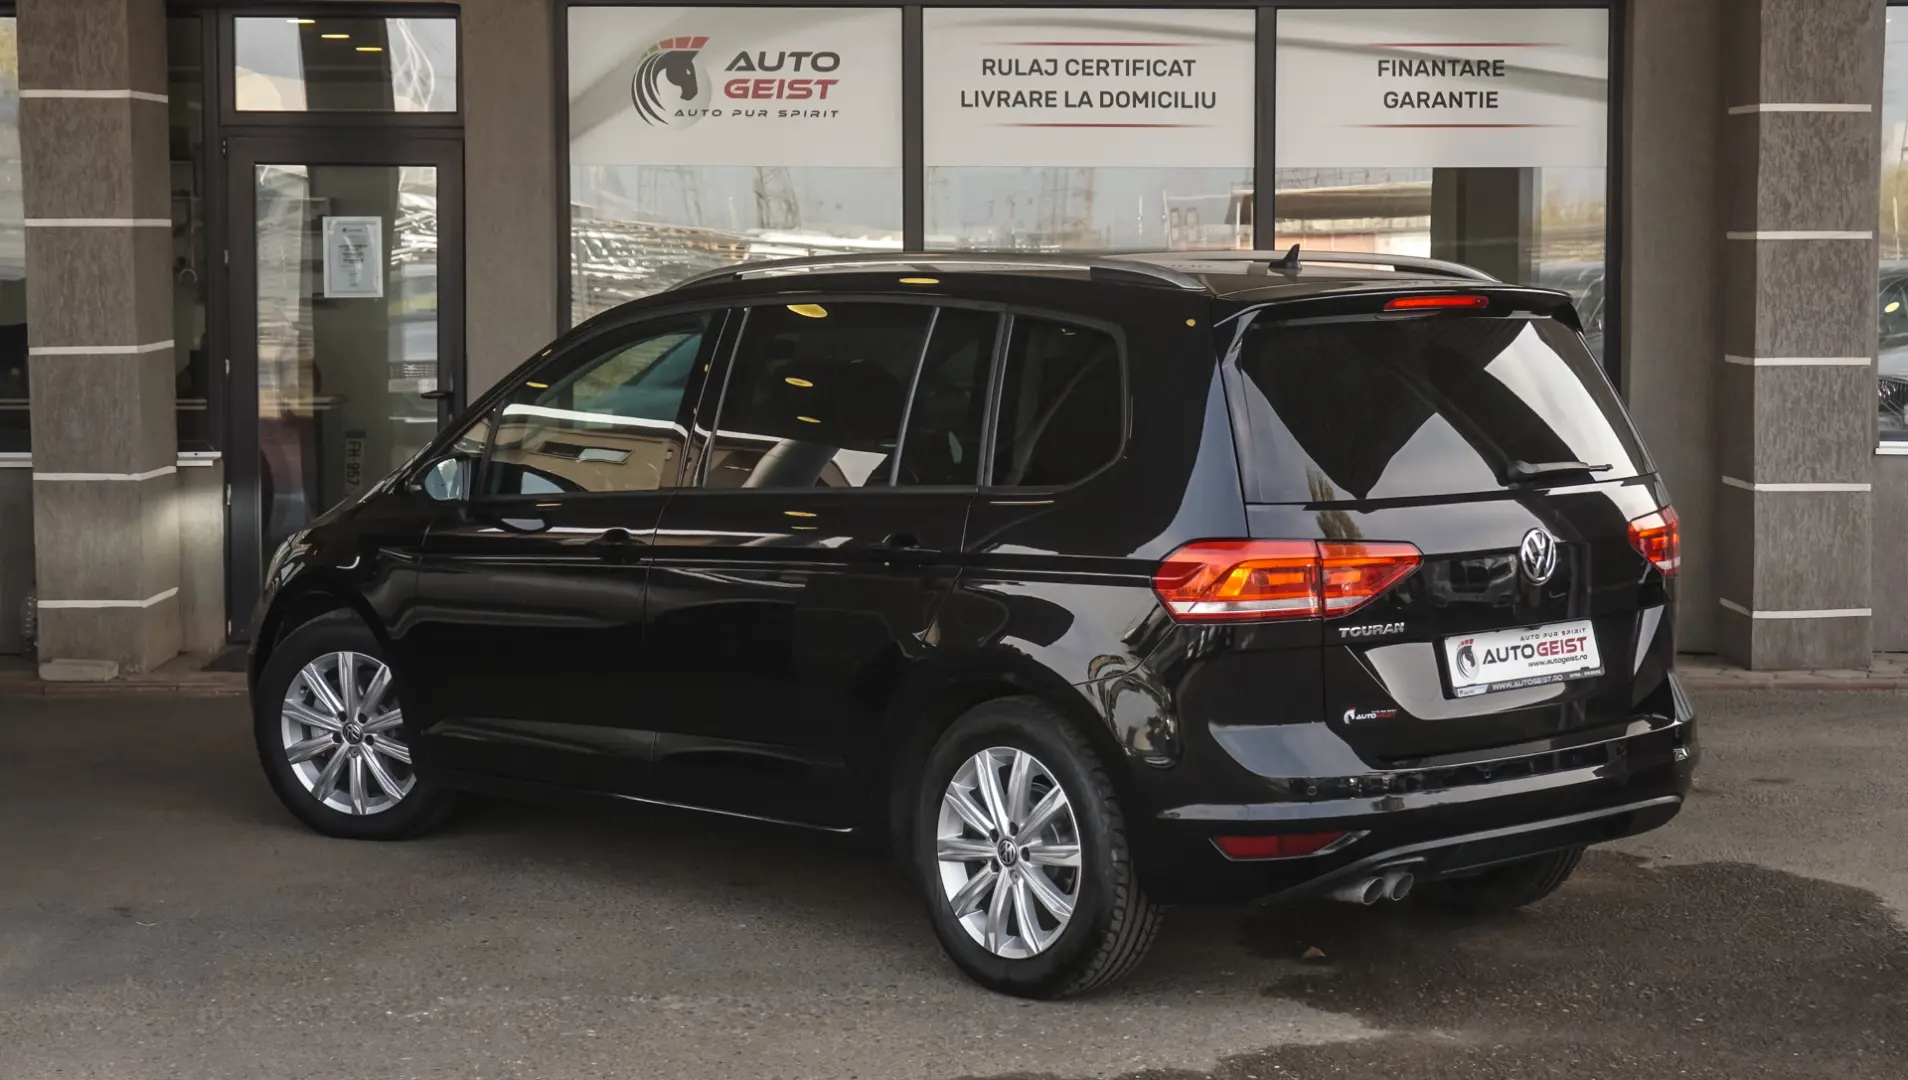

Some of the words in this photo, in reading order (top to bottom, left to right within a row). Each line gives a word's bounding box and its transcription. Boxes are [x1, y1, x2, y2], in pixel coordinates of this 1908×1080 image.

[725, 51, 841, 72] AUTO
[982, 58, 1058, 76] RULAJ
[1065, 58, 1197, 77] CERTIFICAT
[1377, 59, 1505, 77] FINANTARE
[724, 78, 840, 100] GEIST
[960, 90, 1058, 108] LIVRARE
[1064, 90, 1094, 108] LA
[1099, 91, 1217, 109] DOMICILIU
[1383, 91, 1499, 109] GARANTIE
[674, 109, 723, 118] AUTO
[731, 109, 769, 118] PUR
[778, 109, 840, 118] SPIRIT
[1338, 622, 1405, 638] TOURAN
[1519, 633, 1540, 641] AUTO
[1561, 627, 1587, 636] SPIRIT
[1482, 636, 1588, 665] AUTOGEIST
[1528, 654, 1588, 668] www.autogeist.ro
